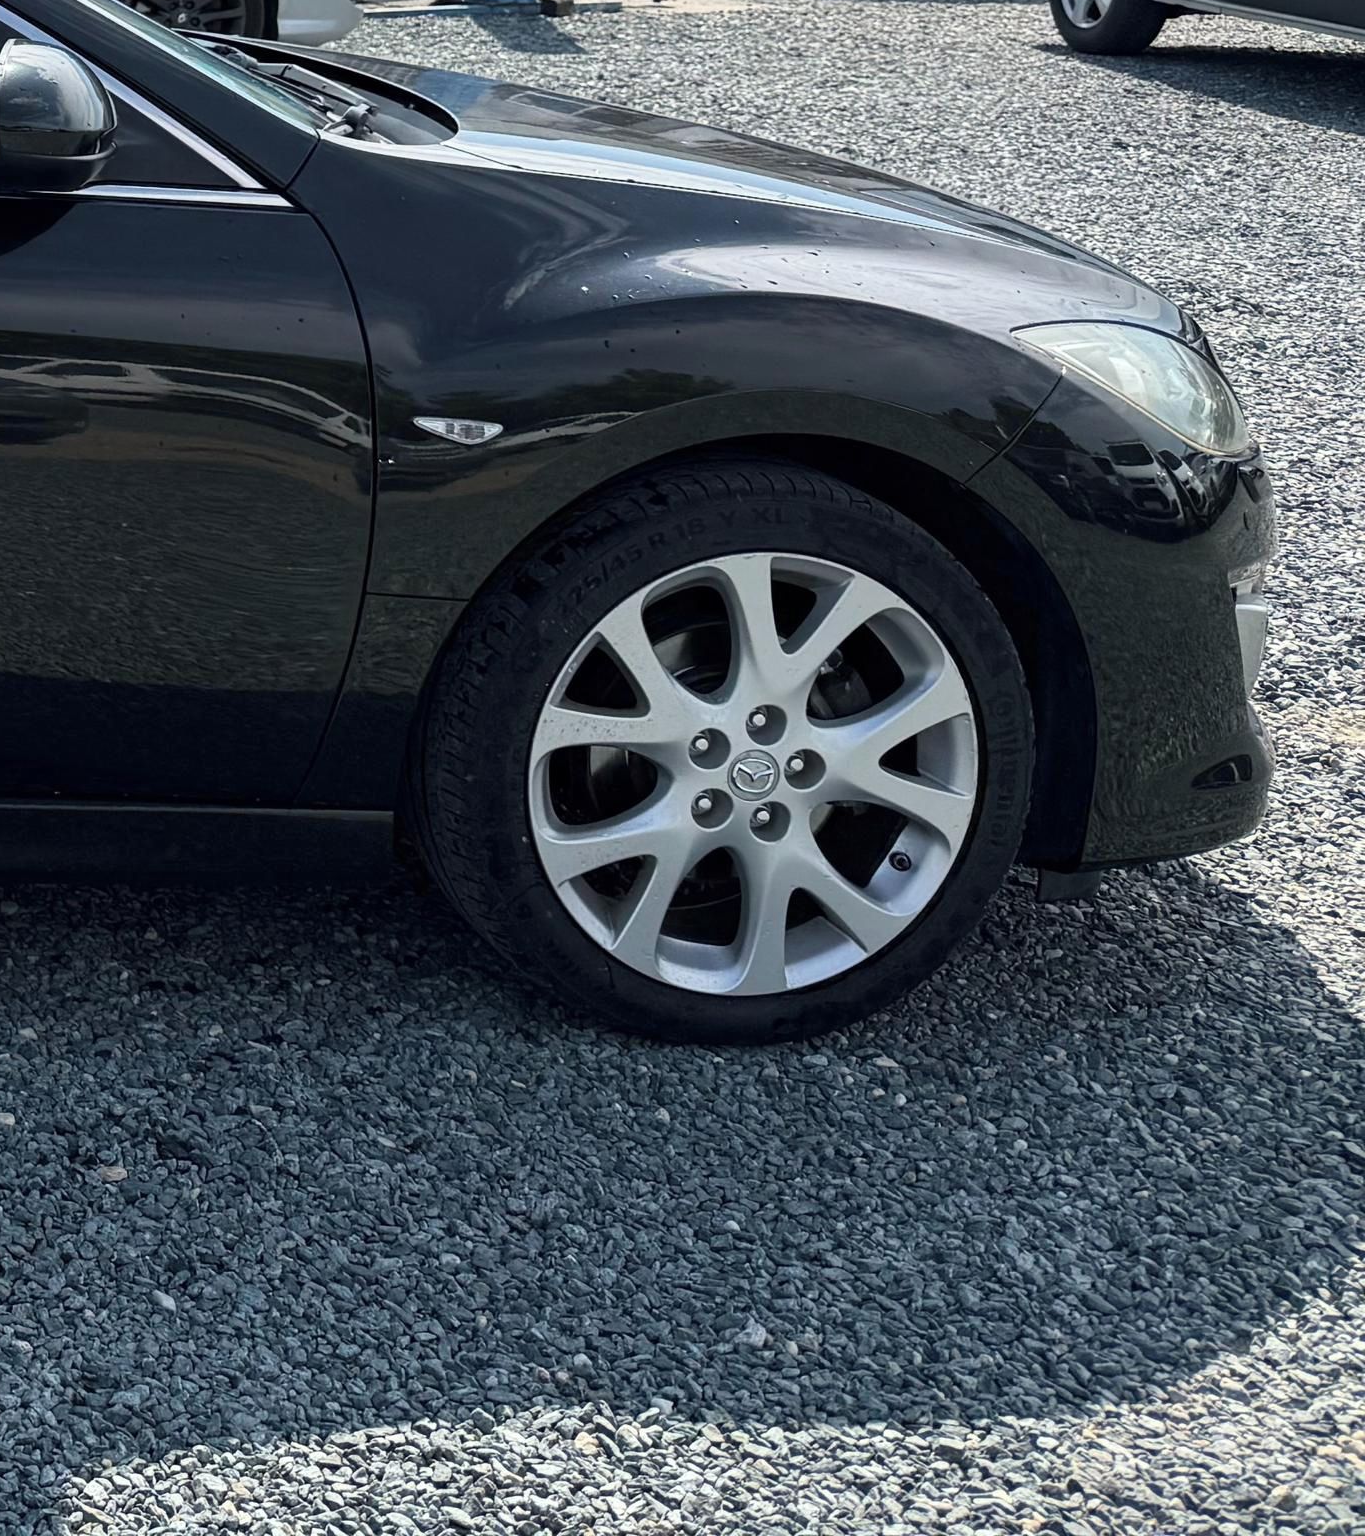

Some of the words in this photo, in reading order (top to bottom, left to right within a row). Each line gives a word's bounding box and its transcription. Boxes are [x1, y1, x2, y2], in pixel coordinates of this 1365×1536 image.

[648, 531, 666, 550] R
[674, 517, 706, 539] 18
[719, 510, 736, 528] Y
[753, 507, 789, 525] XL
